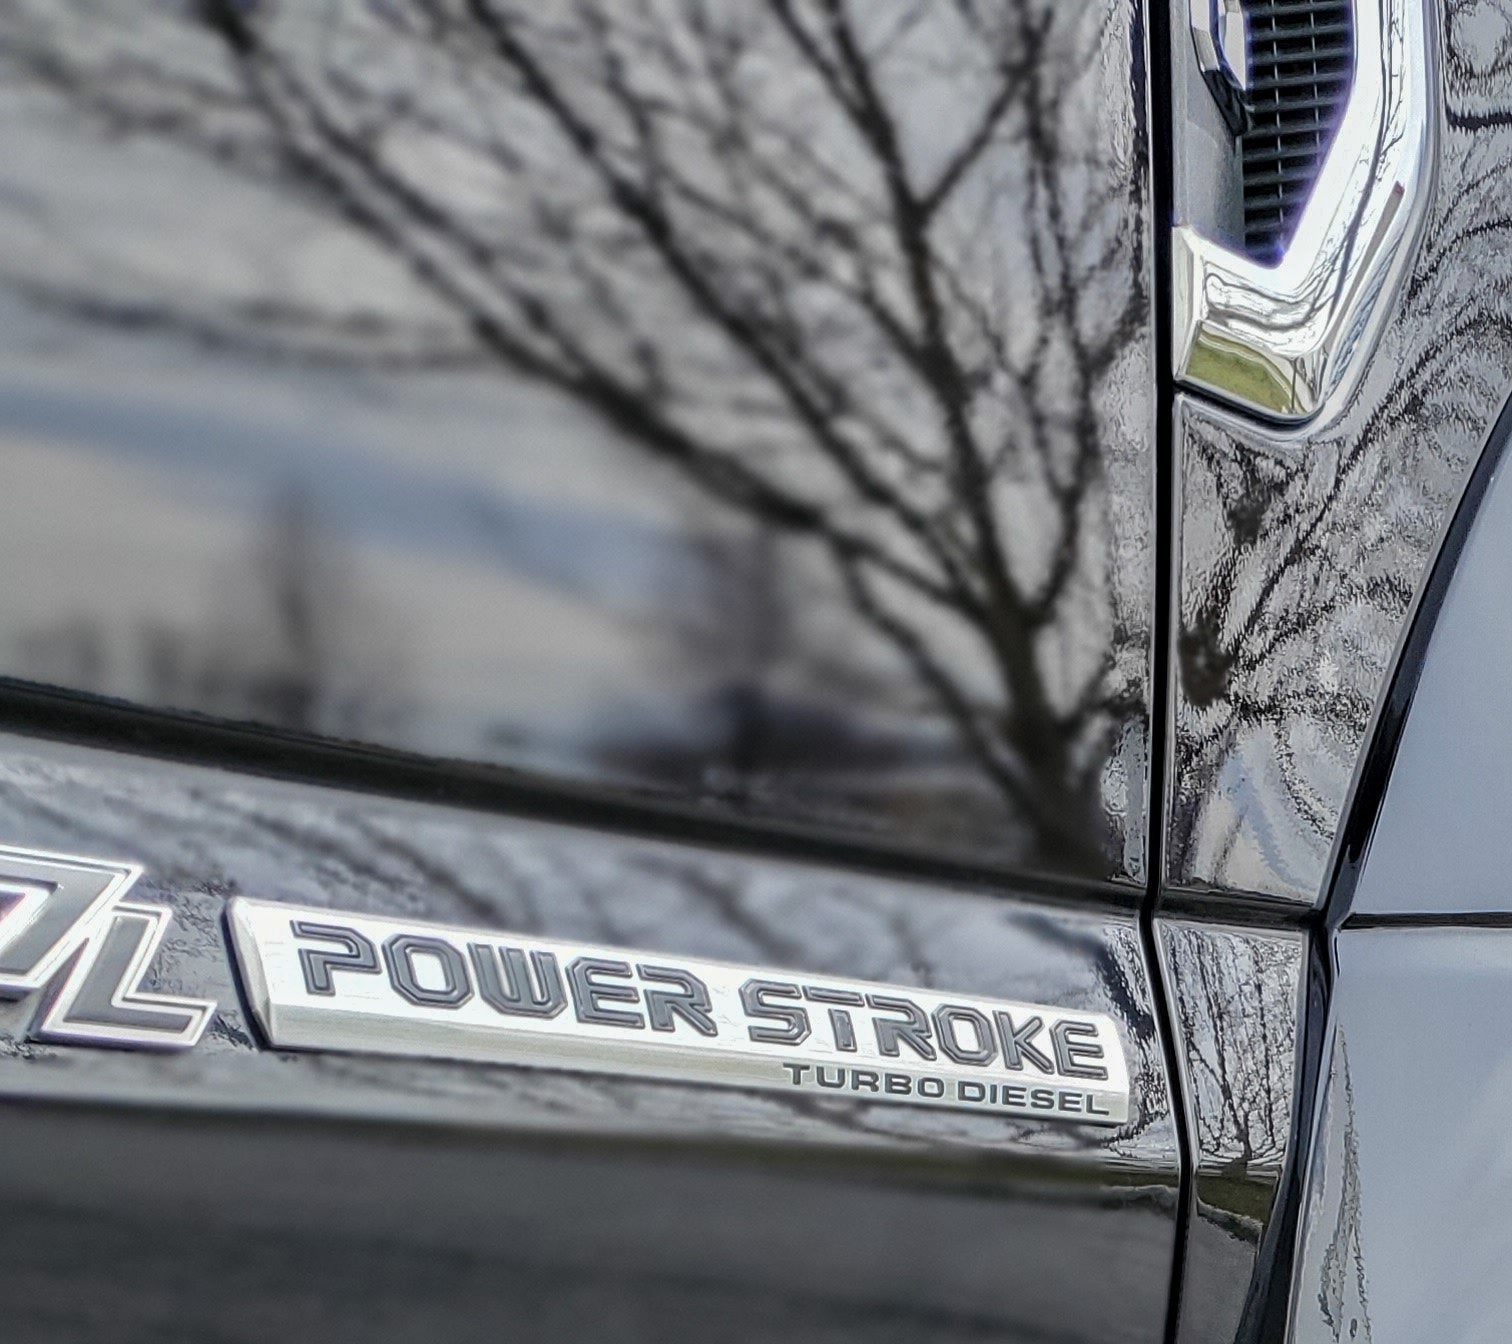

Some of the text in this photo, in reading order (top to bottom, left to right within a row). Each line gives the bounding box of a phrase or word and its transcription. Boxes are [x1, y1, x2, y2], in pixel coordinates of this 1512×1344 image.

[290, 919, 1109, 1080] POWER STROKE
[782, 1061, 1110, 1117] TURBO DIESEL
